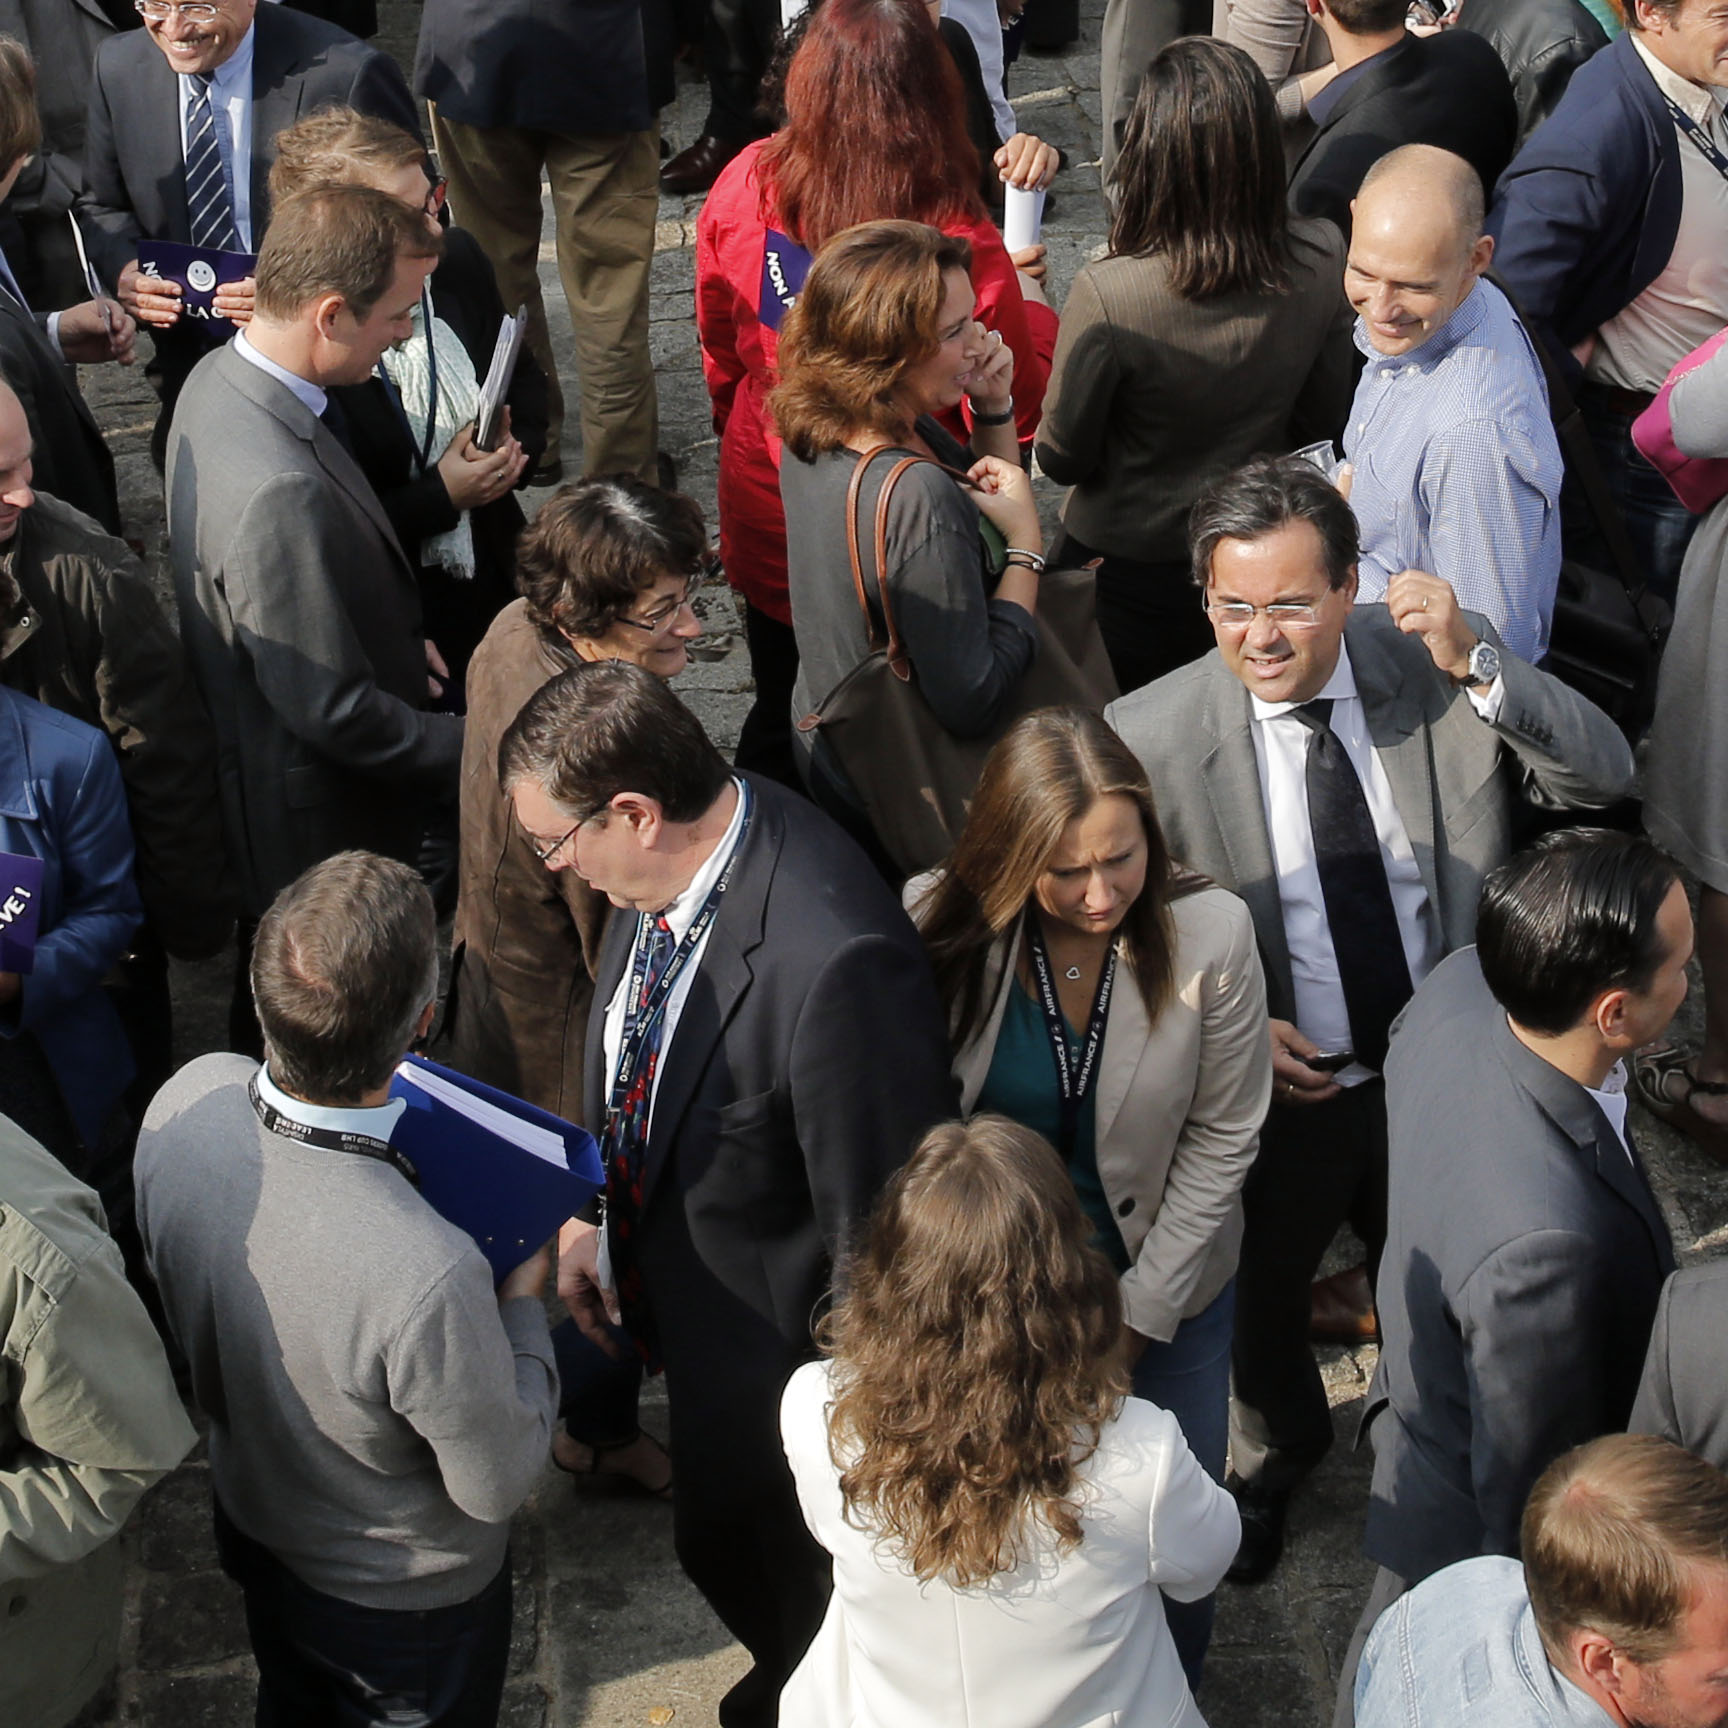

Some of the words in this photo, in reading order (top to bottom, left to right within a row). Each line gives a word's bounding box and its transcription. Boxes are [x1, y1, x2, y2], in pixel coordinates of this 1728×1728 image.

[766, 252, 788, 296] NON
[1034, 955, 1056, 1016] AIRFRANCE
[1077, 1041, 1097, 1096] AIRFRANCE
